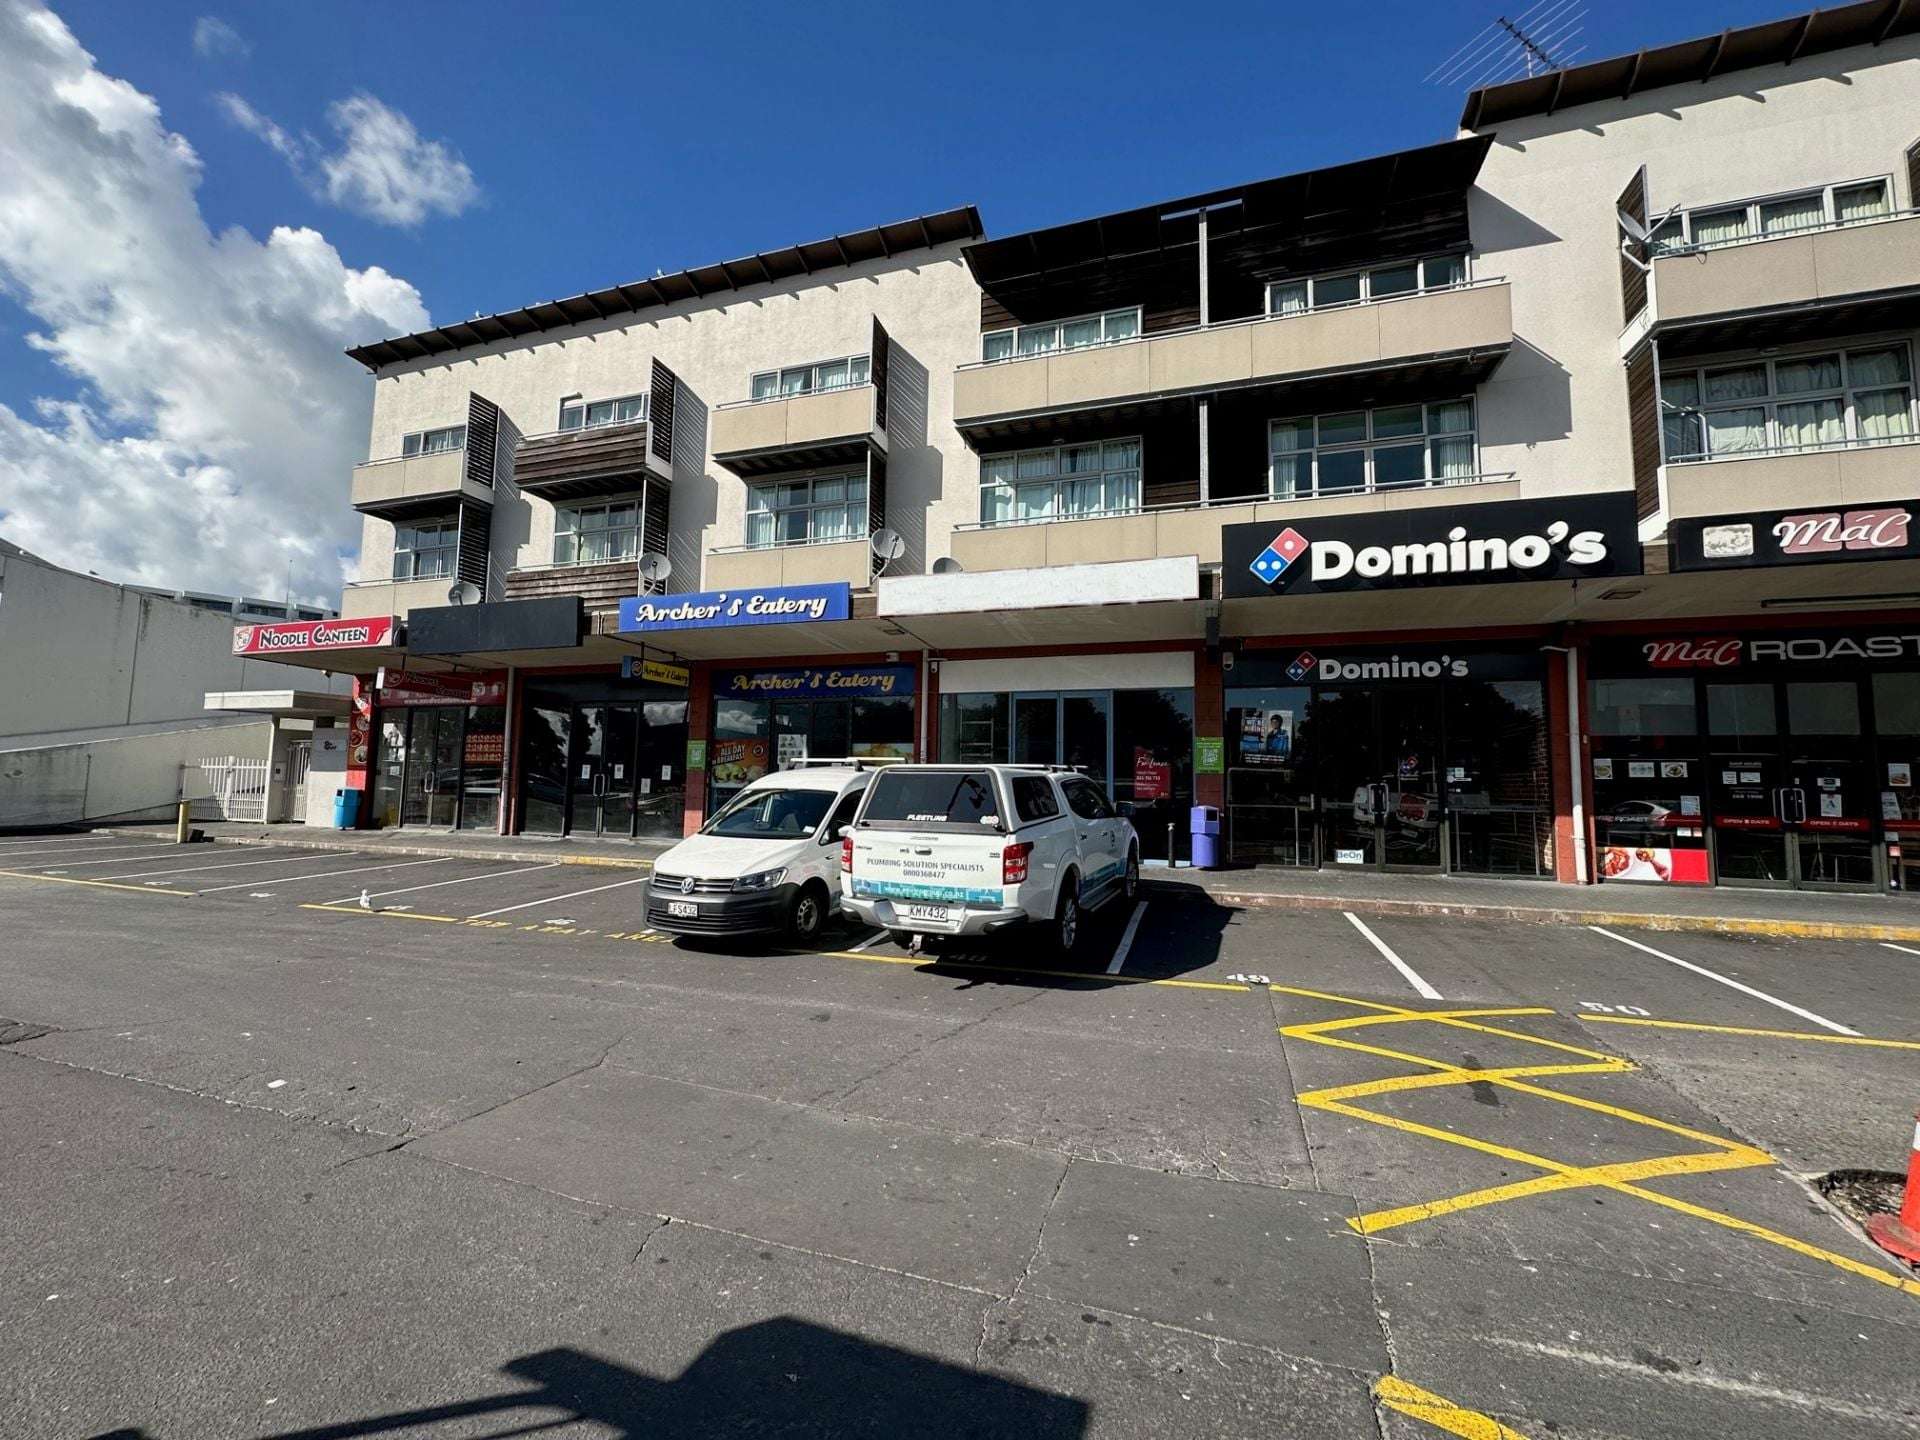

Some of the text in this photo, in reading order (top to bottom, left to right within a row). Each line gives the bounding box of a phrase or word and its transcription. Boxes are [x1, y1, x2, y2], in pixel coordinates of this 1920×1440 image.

[1311, 520, 1608, 582] Domino's
[636, 594, 827, 622] Archer's Eatery
[259, 624, 368, 648] NOODLE CANTEEN
[1319, 655, 1469, 680] Domino's
[731, 670, 896, 692] Archer's Eatery
[732, 744, 746, 754] DAY
[867, 858, 985, 872] PLUMBING SOLUTION SPECIALISTS
[910, 905, 946, 920] KMY432
